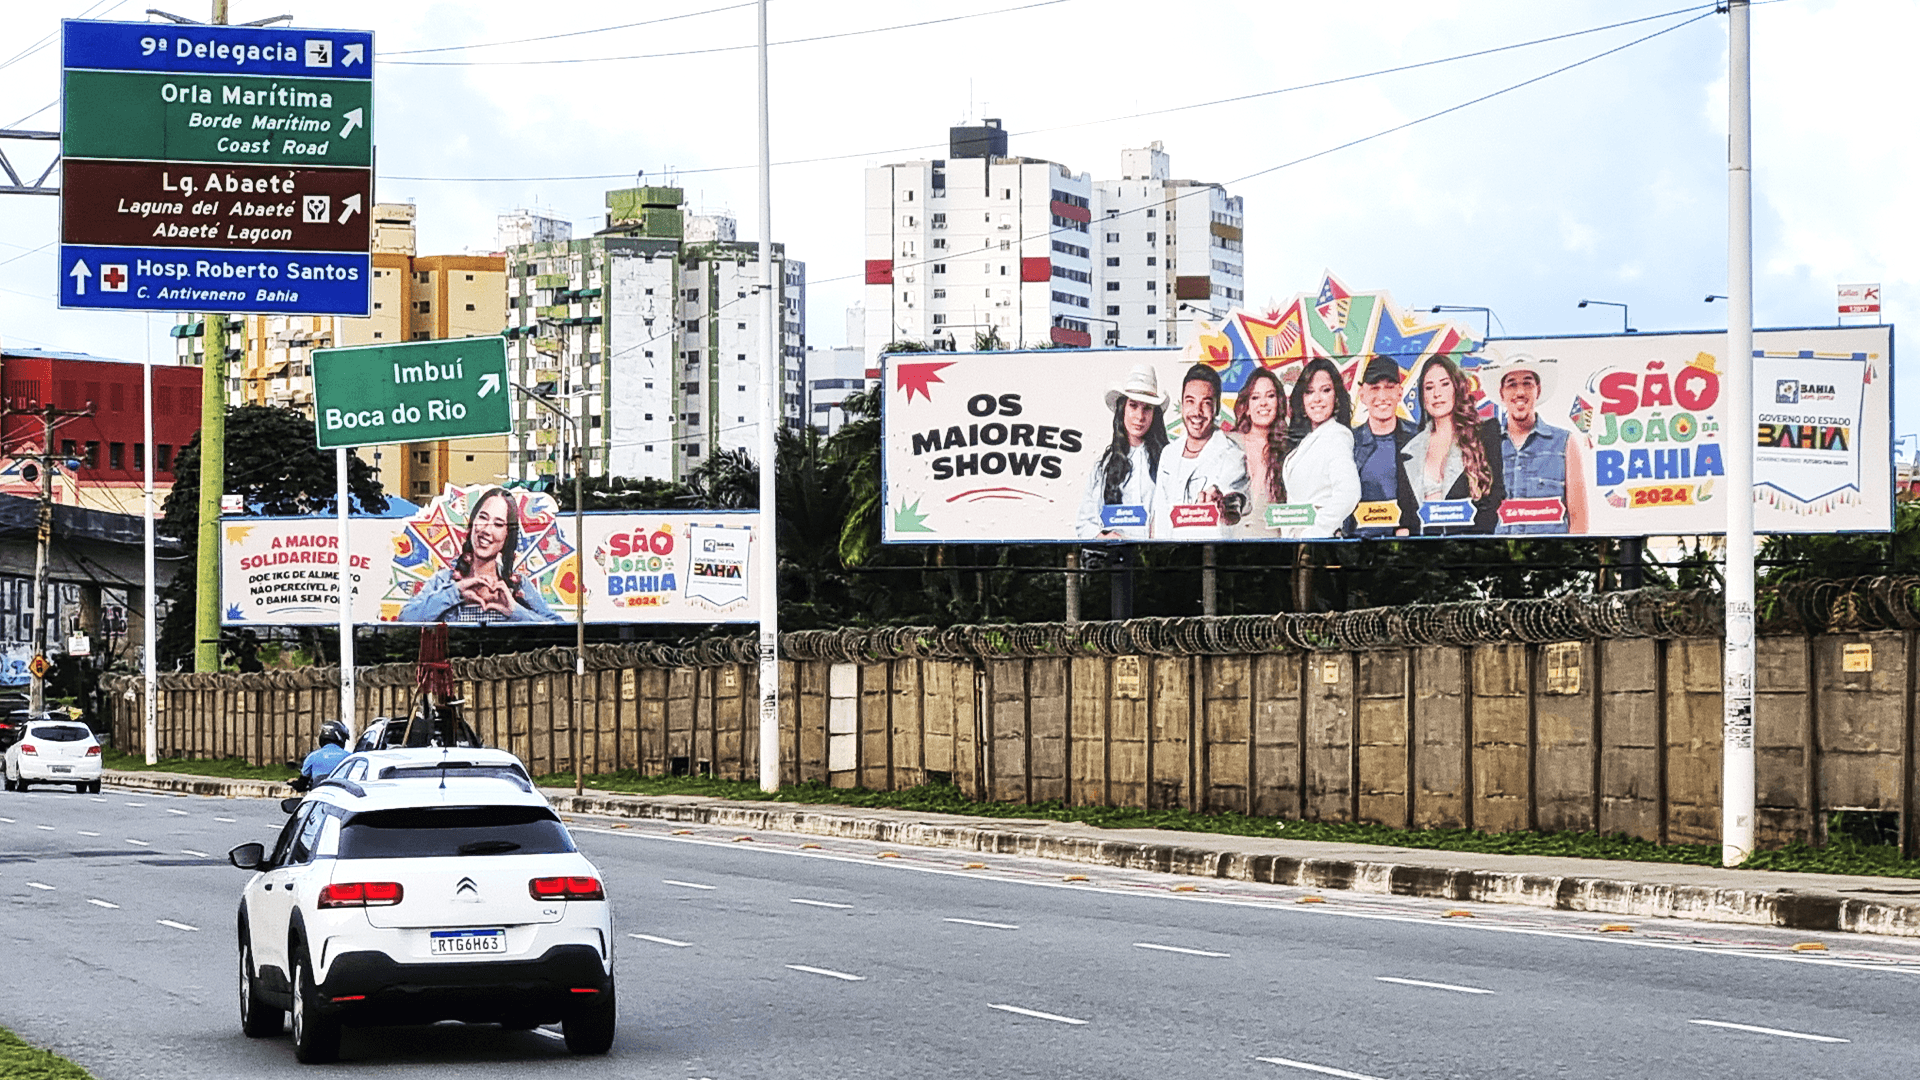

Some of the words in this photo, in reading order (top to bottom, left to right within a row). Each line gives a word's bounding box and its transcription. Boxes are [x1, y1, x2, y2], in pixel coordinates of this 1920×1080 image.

[176, 39, 298, 64] Delegacia
[161, 84, 212, 103] Orla
[222, 83, 332, 108] Marítima
[189, 113, 242, 128] Borde
[251, 114, 331, 132] Marítimo
[217, 138, 271, 153] Coast
[282, 139, 330, 155] Road
[162, 172, 198, 197] Lg.
[205, 172, 295, 194] Abaeté
[118, 199, 183, 219] Laguna
[192, 200, 218, 215] del
[230, 201, 295, 218] Abaeté
[153, 223, 219, 238] Abaeté
[227, 226, 293, 244] Lagoon
[136, 260, 191, 283] Hosp.
[196, 261, 279, 280] Roberto
[287, 263, 359, 281] Santos
[137, 286, 150, 299] C.
[158, 287, 246, 301] Antiveneno
[256, 290, 299, 303] Bahia
[394, 358, 463, 384] Imbuí
[1599, 360, 1720, 416] SÃO
[1800, 384, 1836, 394] BAHIA
[325, 408, 385, 430] Boca
[391, 403, 421, 424] do
[428, 399, 466, 421] Rio
[967, 393, 1023, 417] OS
[1597, 412, 1698, 445] JOÃO
[1701, 422, 1719, 432] DA
[1759, 414, 1800, 423] GOVERNO
[1803, 416, 1816, 424] DO
[1818, 417, 1850, 426] ESTADO
[912, 423, 1083, 455] MAIORES
[1758, 424, 1850, 450] BAHIA
[931, 452, 1062, 480] SHOWS
[1596, 444, 1725, 486] BAHIA
[1635, 488, 1687, 504] 2024
[271, 537, 282, 549] A
[286, 535, 338, 548] MAIOR
[610, 528, 674, 556] SÃO
[240, 551, 371, 570] SOLIDARIEDDE
[609, 555, 663, 573] JOÃO
[249, 573, 270, 583] DOE
[293, 571, 305, 579] DE
[251, 583, 272, 595] NÃO
[274, 580, 327, 591] PERECÍVEL
[608, 574, 676, 595] BAHIA
[267, 596, 298, 604] BAHIA
[629, 597, 657, 605] 2024
[439, 938, 498, 951] RTG6H63
